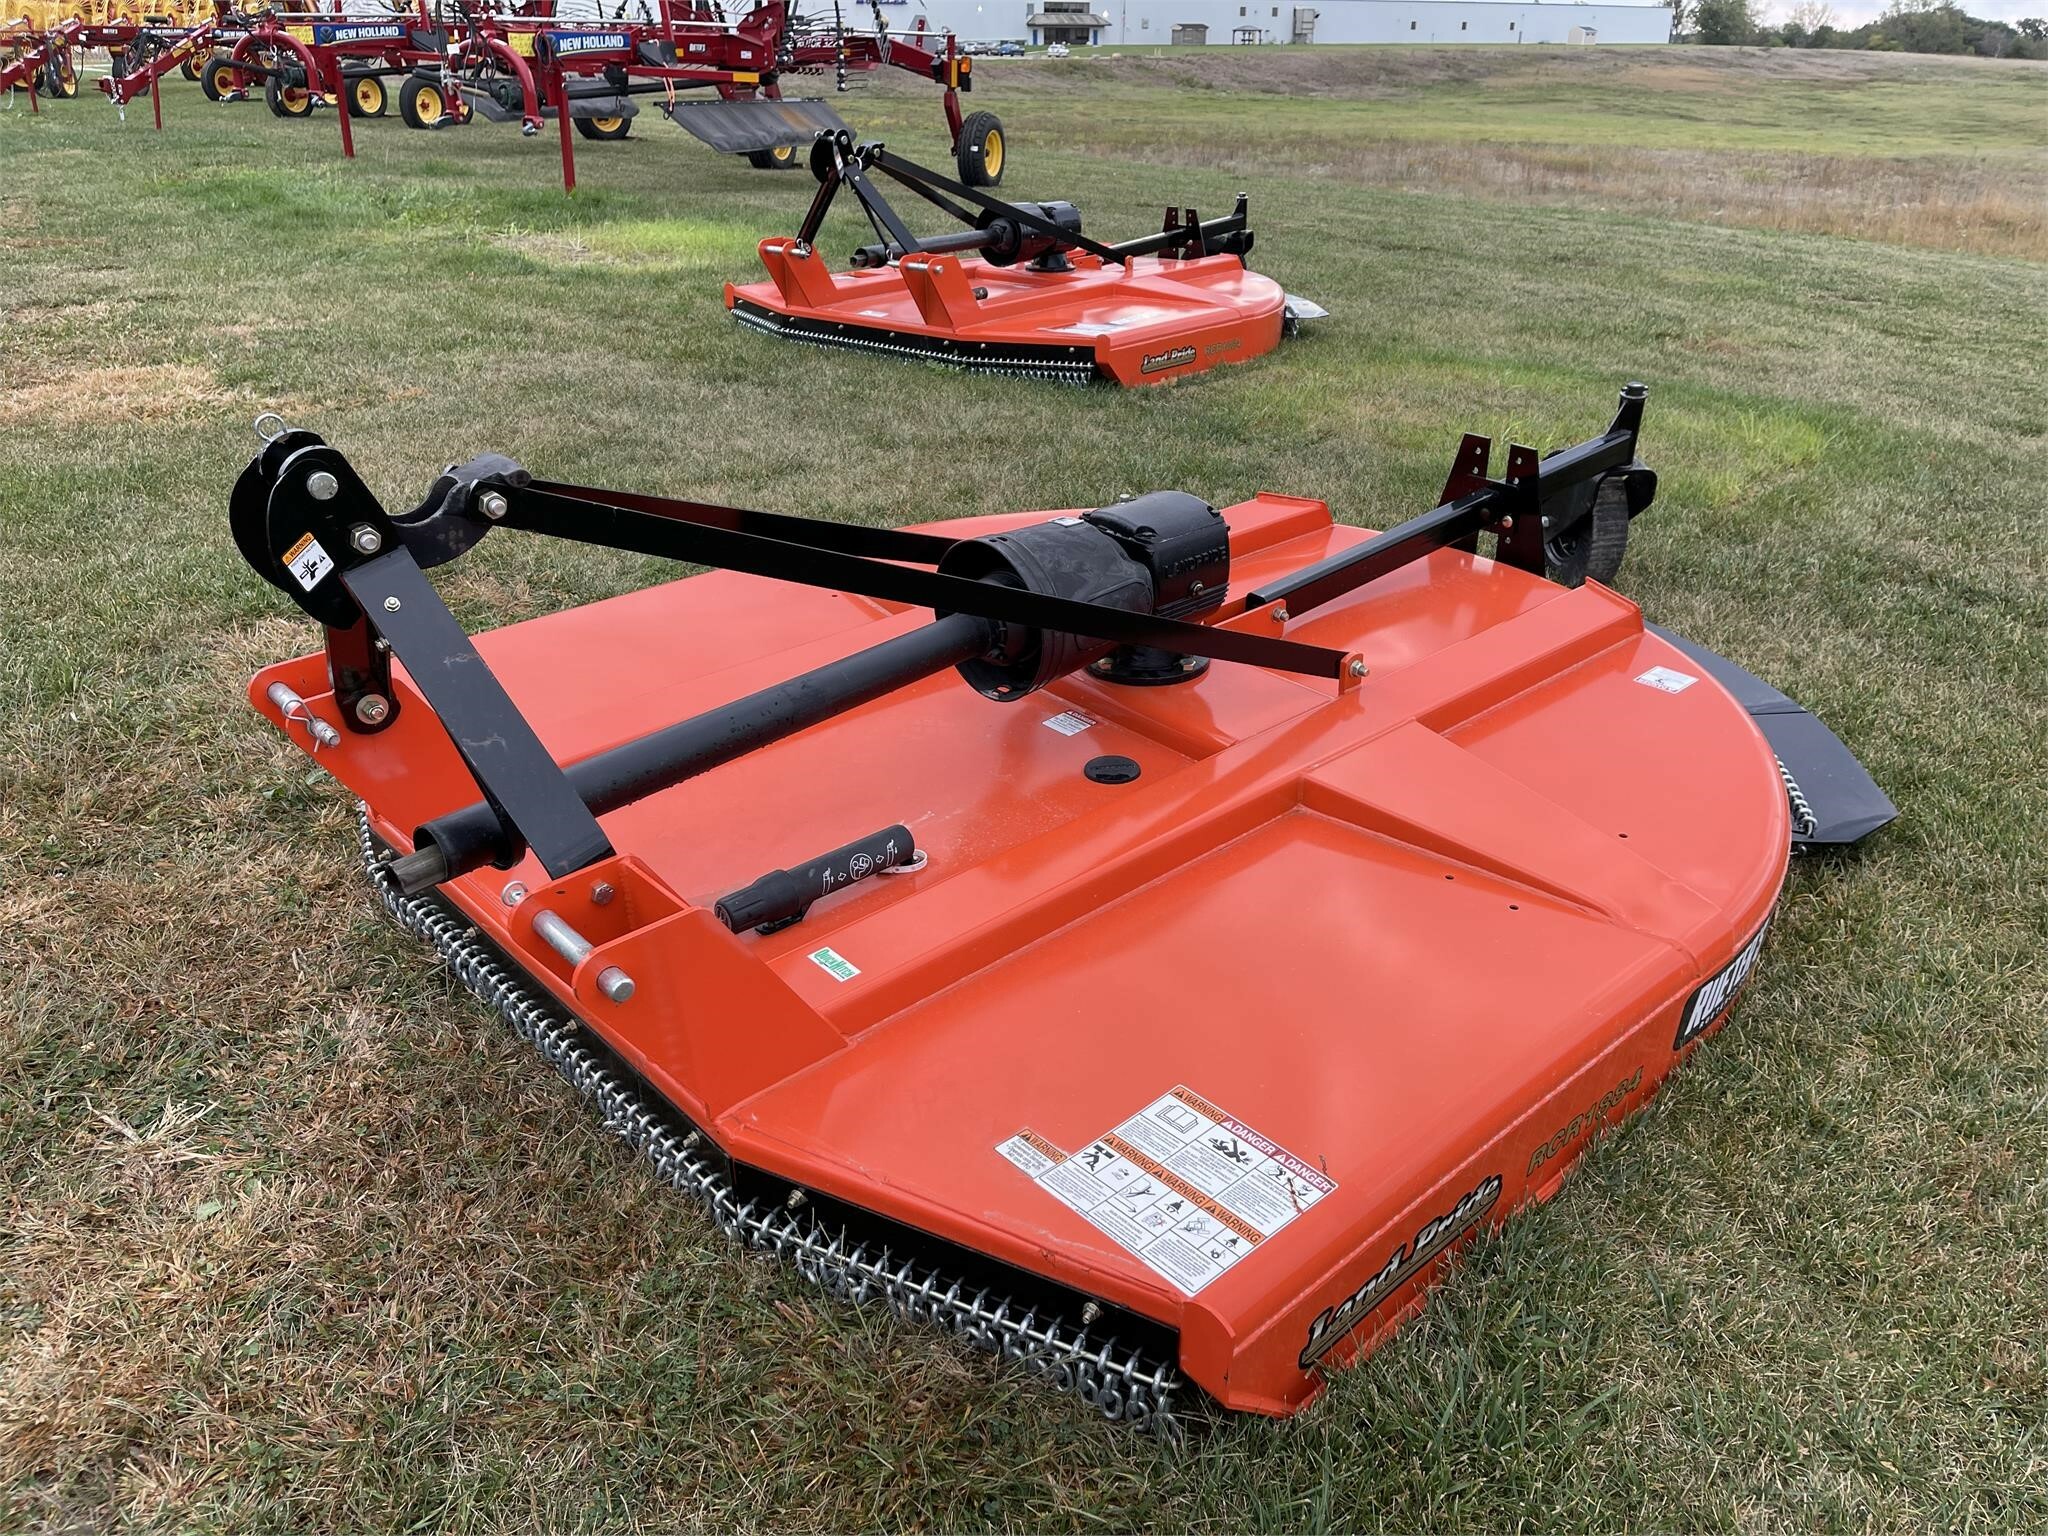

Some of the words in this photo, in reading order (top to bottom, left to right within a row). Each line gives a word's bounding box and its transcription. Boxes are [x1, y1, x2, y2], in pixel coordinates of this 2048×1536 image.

[335, 27, 357, 40] NEW
[358, 26, 399, 38] HOLLAND
[560, 36, 581, 52] NEW
[582, 35, 624, 49] HOLLAND
[1143, 351, 1169, 367] Land
[289, 534, 311, 557] WARNING
[1184, 1094, 1223, 1121] WARNING
[1526, 1065, 1644, 1177] RCR1884
[1030, 1137, 1063, 1163] WARNING
[1231, 1125, 1276, 1155] DANGER
[1113, 1141, 1154, 1170] WARNING
[1163, 1174, 1205, 1204] WARNING
[1284, 1158, 1331, 1191] DANGER
[1216, 1209, 1261, 1243] WARNING
[1306, 1244, 1405, 1347] Land
[1409, 1177, 1501, 1265] Pride
